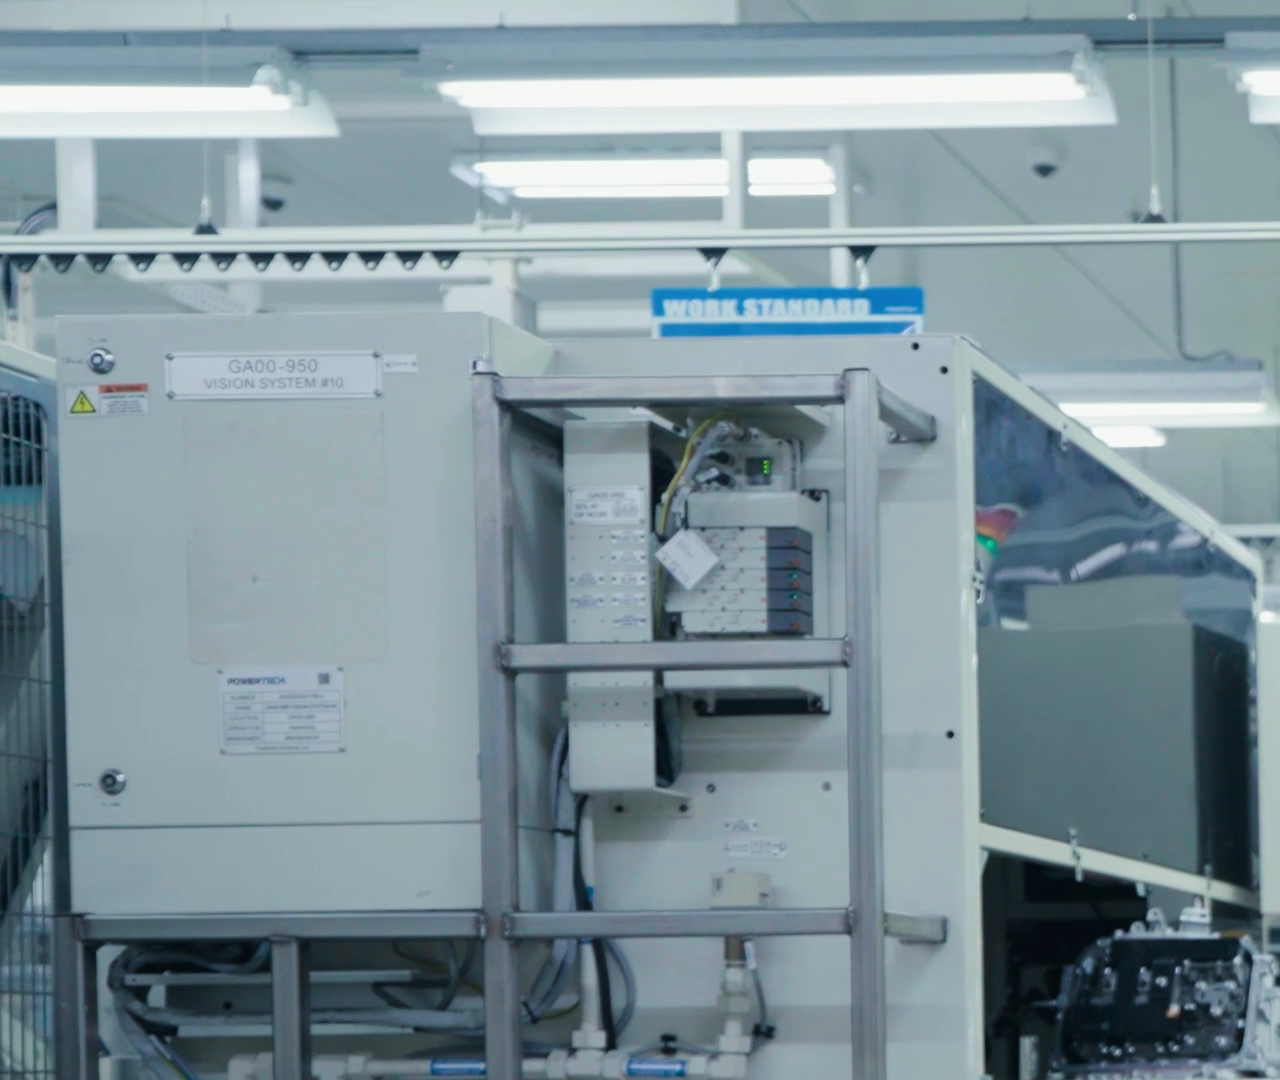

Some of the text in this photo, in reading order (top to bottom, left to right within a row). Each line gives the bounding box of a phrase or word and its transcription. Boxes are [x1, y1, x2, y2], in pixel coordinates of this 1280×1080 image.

[662, 298, 871, 317] WORK STANDARD
[228, 358, 318, 374] GA00-950
[203, 377, 344, 390] VISION SYSTEM #10
[227, 676, 285, 686] POWERTECH
